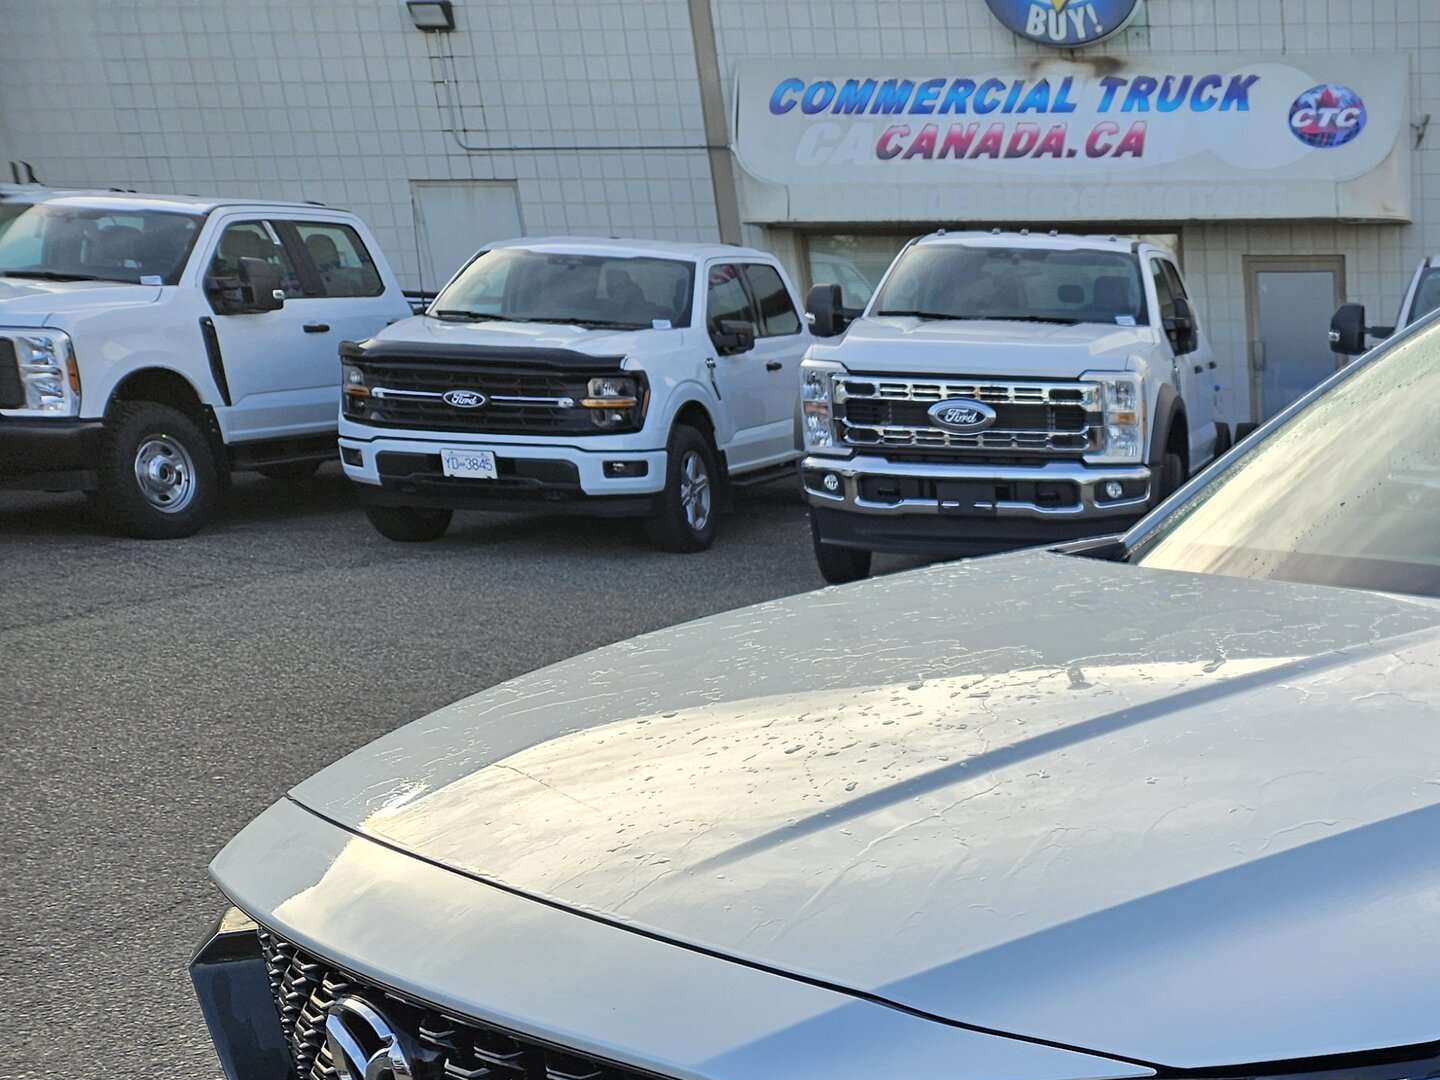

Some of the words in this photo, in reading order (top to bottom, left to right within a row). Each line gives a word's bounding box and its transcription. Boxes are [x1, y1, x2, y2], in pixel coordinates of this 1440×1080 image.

[1025, 3, 1103, 41] BUY!
[768, 76, 1077, 115] COMMERCIAL
[1096, 74, 1261, 113] TRUCK
[1290, 107, 1361, 129] CTC
[875, 120, 1147, 161] CANADA.CA
[451, 392, 478, 405] Ford
[944, 408, 978, 424] Ford
